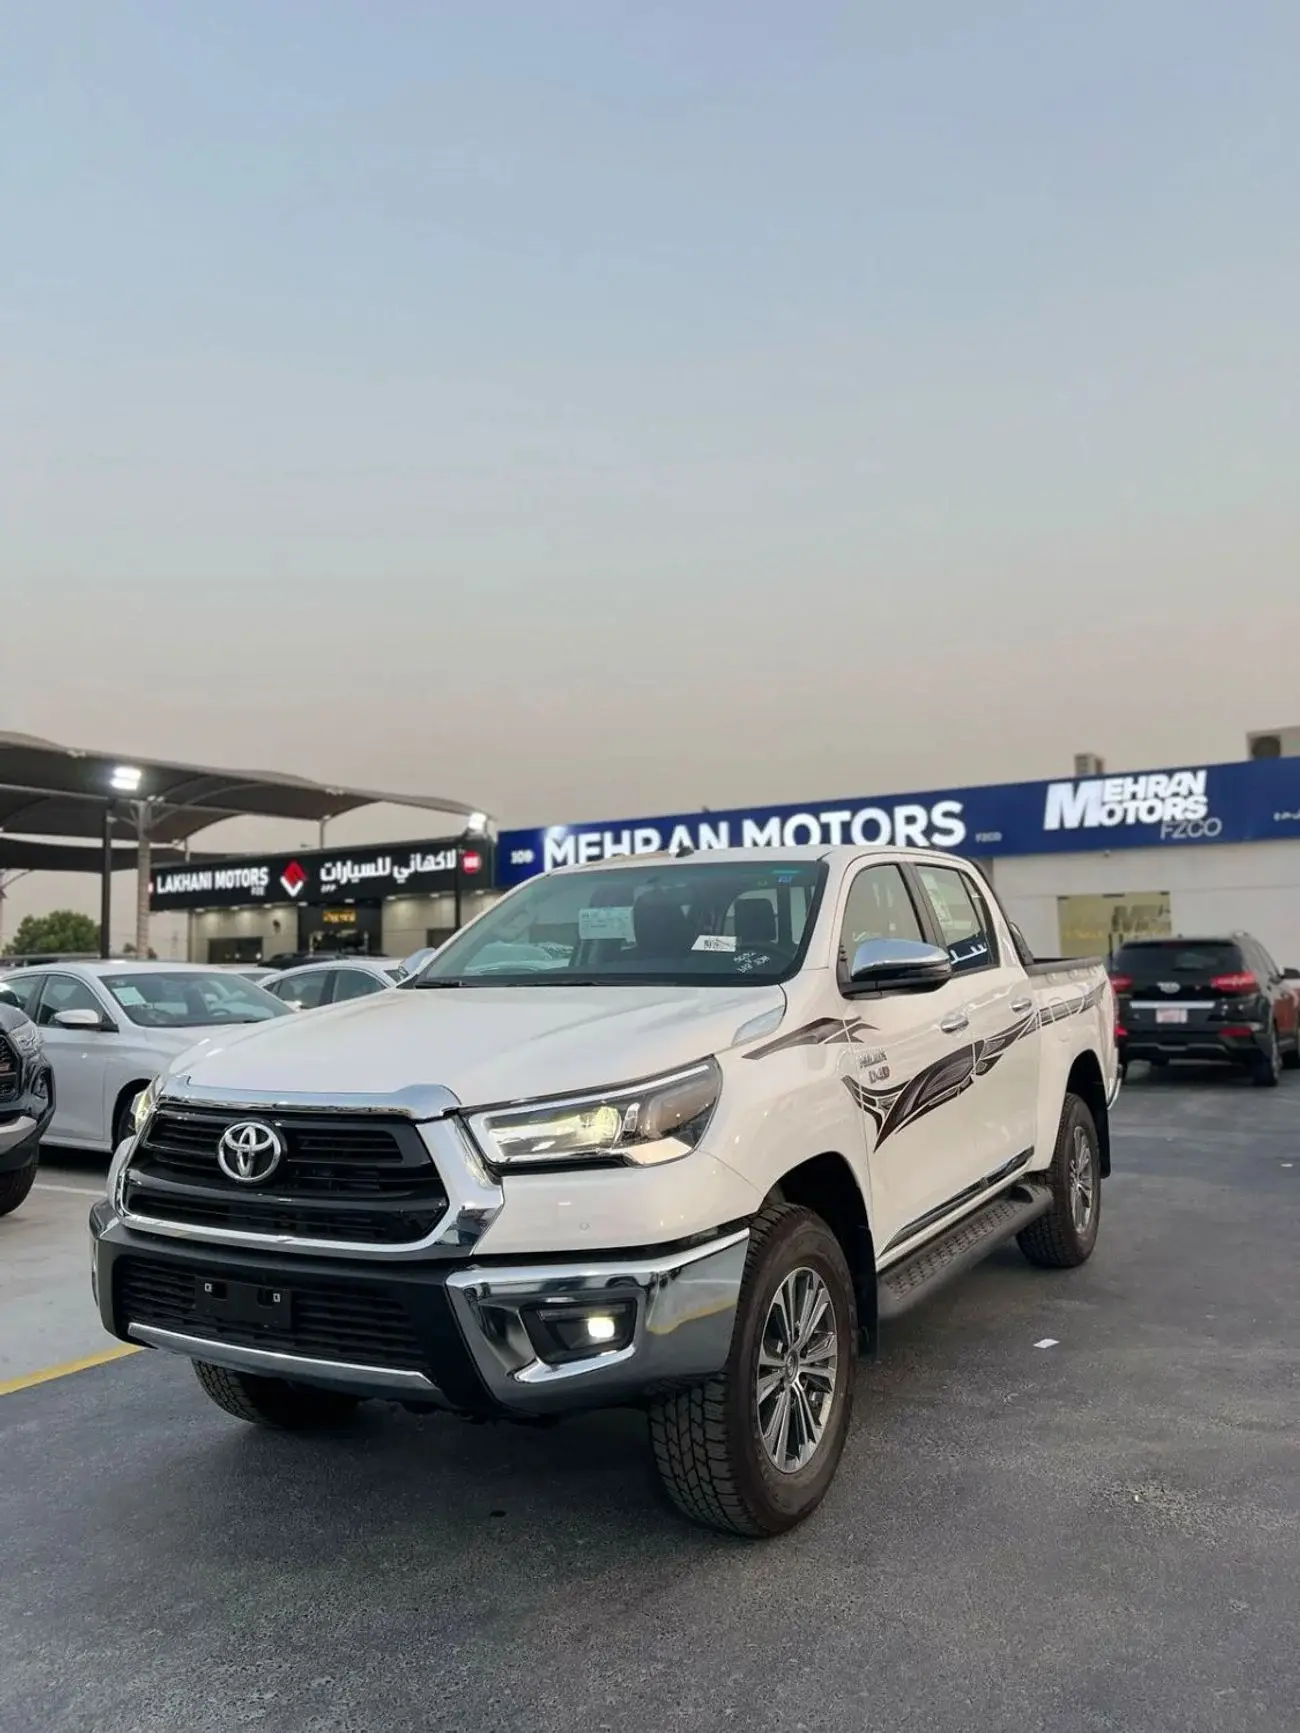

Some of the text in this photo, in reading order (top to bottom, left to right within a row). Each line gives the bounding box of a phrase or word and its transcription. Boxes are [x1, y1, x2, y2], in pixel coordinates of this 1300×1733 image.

[1043, 769, 1208, 831] MEHRAN
[742, 800, 967, 848] MOTORS
[1160, 817, 1222, 840] FZCO
[156, 866, 269, 894] LAKHANI MOTORS
[320, 849, 457, 885] لاكهاني للسيارات
